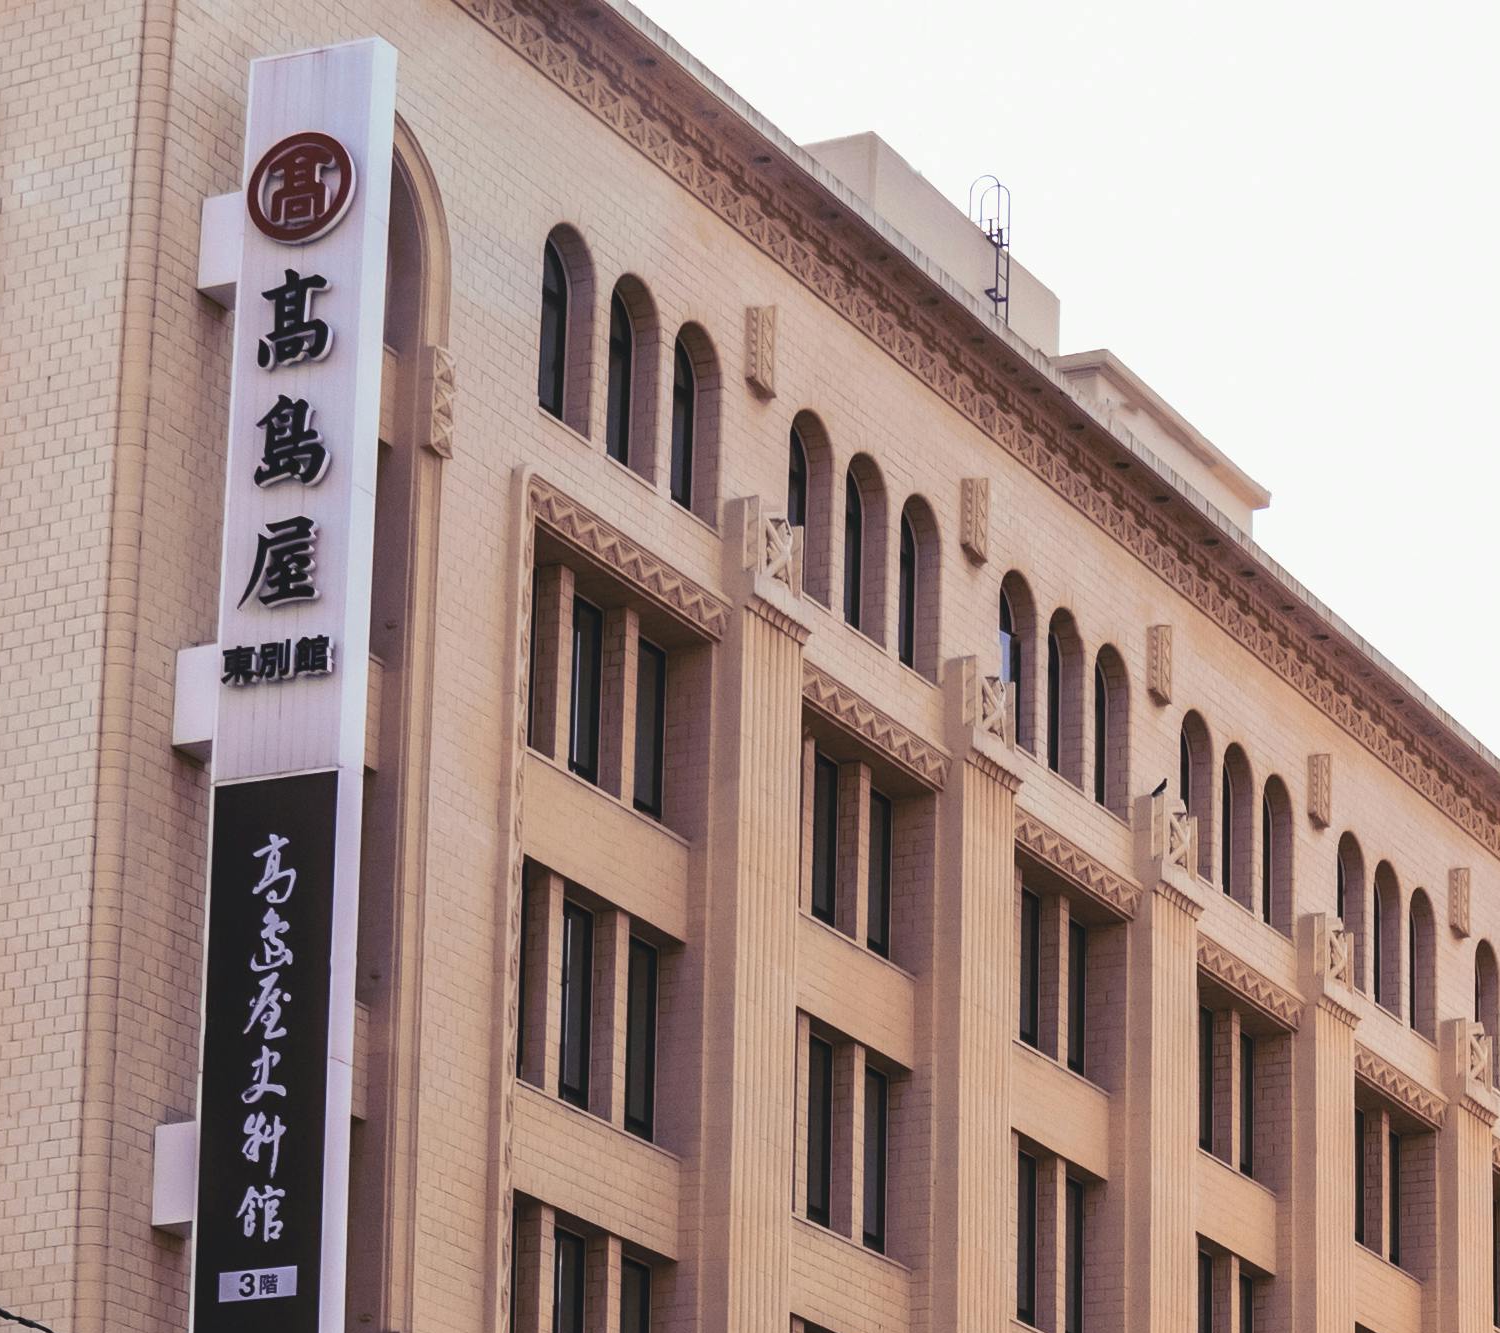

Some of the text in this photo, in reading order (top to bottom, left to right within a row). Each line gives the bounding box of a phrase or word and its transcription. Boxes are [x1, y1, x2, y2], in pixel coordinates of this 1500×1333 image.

[221, 633, 331, 686] 東別館
[239, 1272, 278, 1298] 3階
